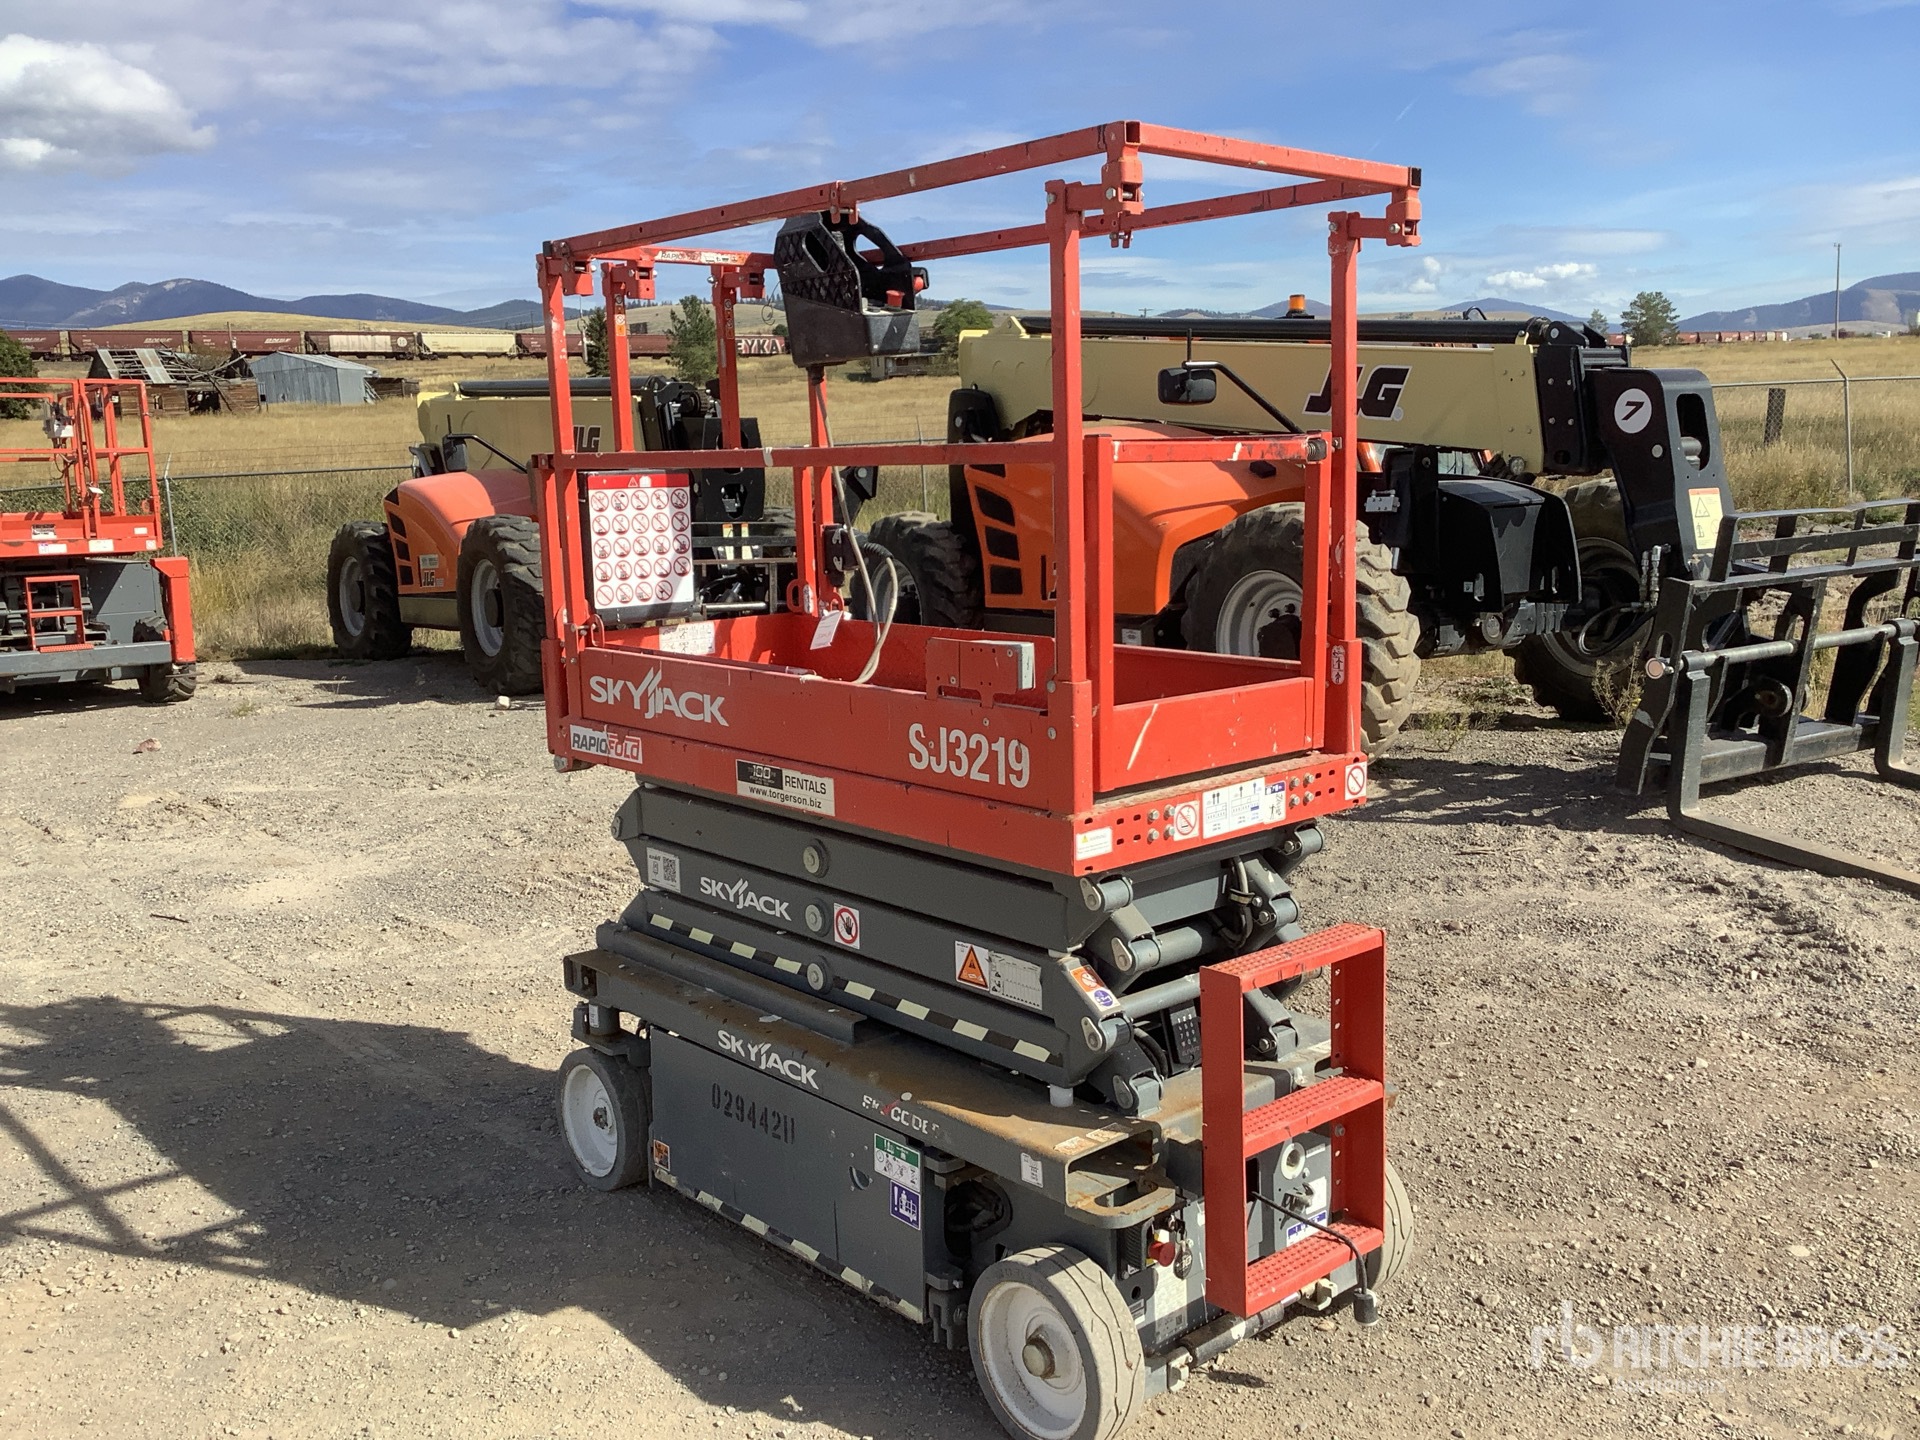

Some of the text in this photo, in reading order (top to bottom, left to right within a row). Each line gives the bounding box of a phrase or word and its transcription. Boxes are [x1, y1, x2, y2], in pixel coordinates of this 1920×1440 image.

[1302, 364, 1412, 420] JG
[1621, 400, 1645, 421] 7
[589, 666, 730, 727] SKYJACK
[908, 722, 1031, 789] SJ3219
[748, 785, 822, 809] www.torgerson.biz
[784, 774, 827, 795] RENTALS
[700, 876, 792, 922] SKYJACK
[717, 1029, 820, 1090] SKYJACK
